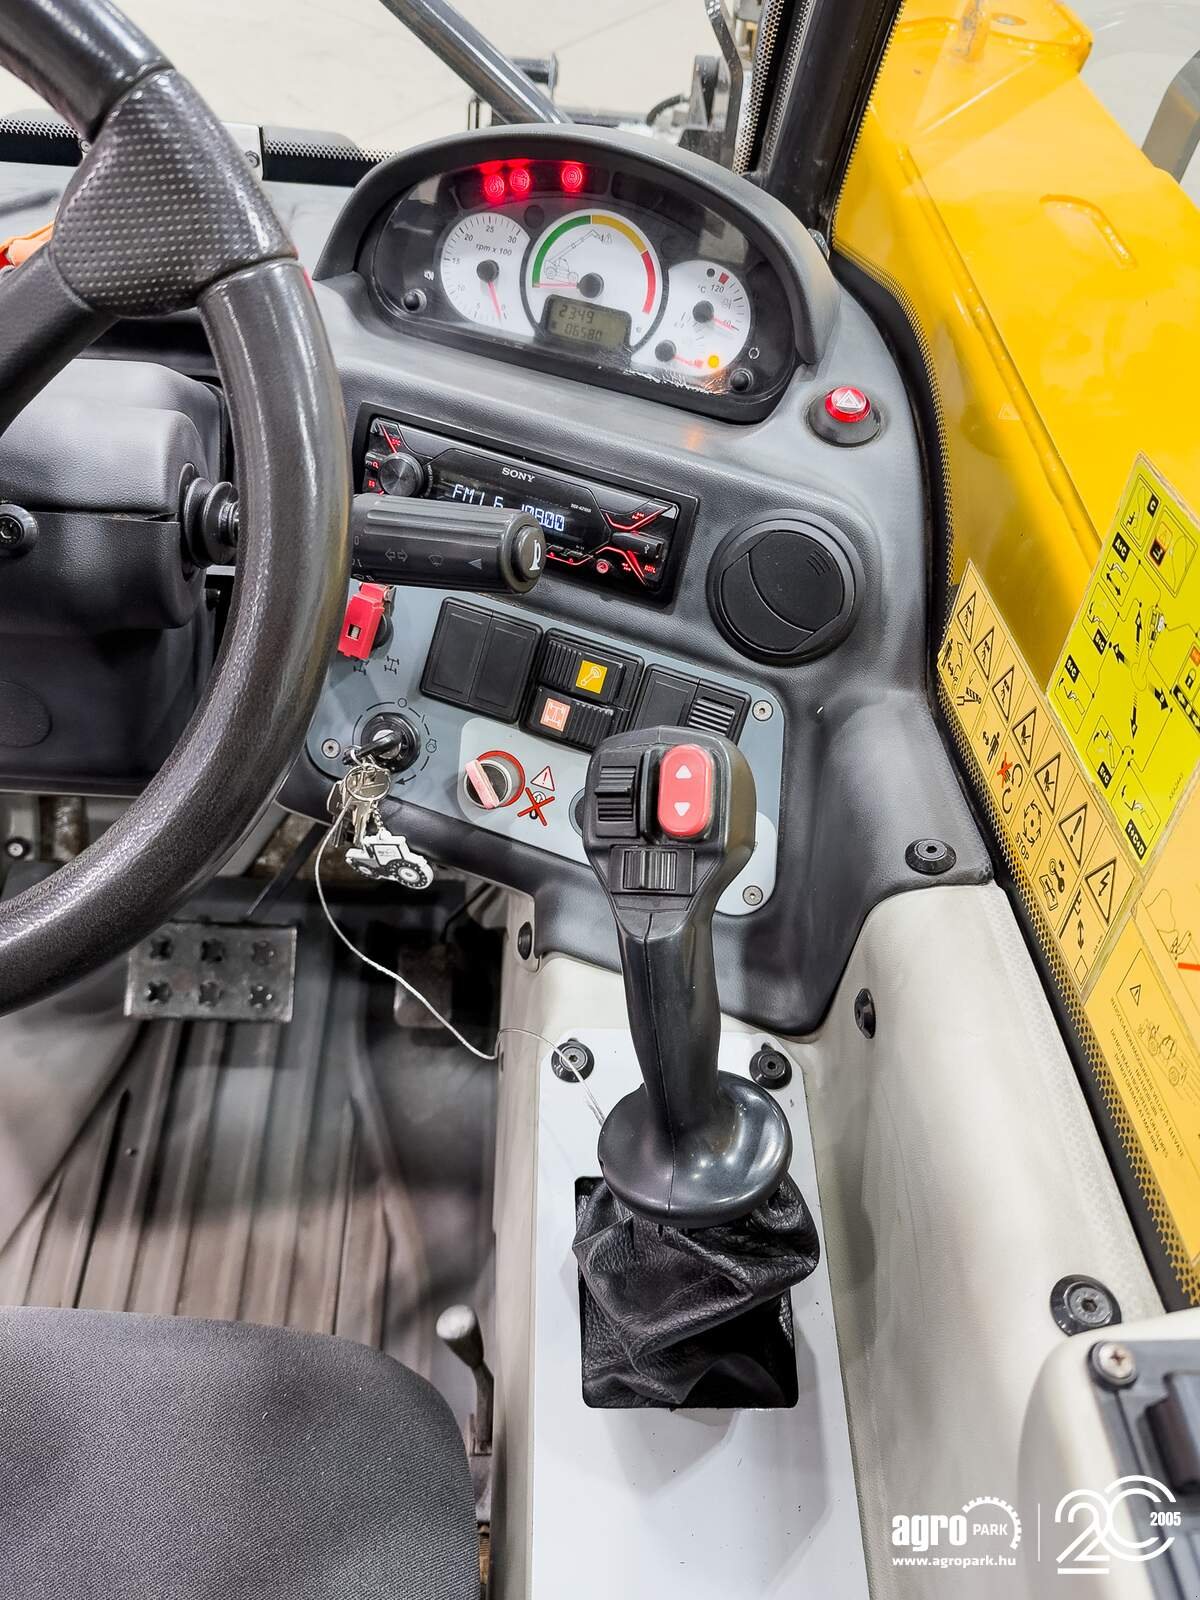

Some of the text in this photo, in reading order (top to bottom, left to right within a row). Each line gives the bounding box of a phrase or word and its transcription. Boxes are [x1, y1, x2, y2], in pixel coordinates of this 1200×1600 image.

[486, 225, 494, 233] 25
[464, 234, 473, 242] 20
[507, 235, 517, 244] 30
[475, 243, 491, 253] rpm
[499, 248, 513, 256] 100
[711, 284, 725, 294] 120
[501, 467, 536, 483] SONY
[1114, 538, 1127, 558] A+C
[1016, 832, 1030, 861] STOP
